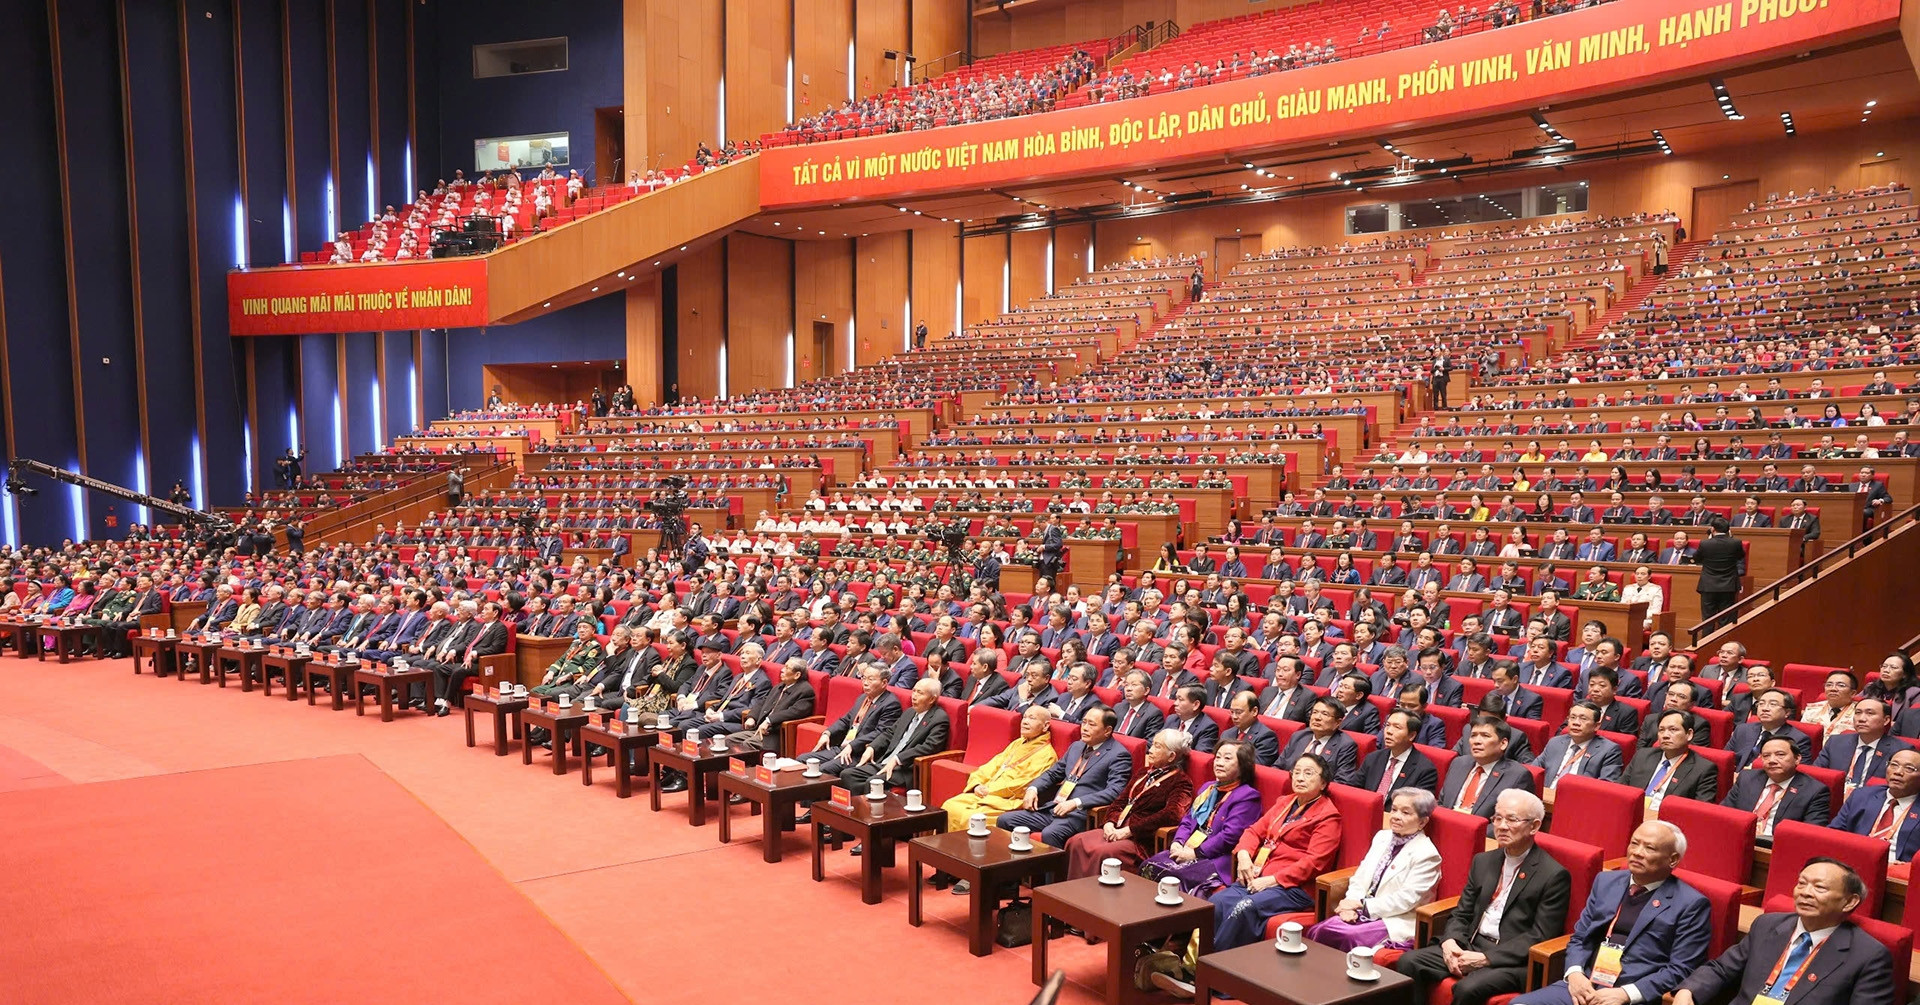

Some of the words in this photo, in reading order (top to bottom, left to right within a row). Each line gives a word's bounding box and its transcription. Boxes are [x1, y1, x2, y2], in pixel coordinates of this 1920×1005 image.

[792, 157, 819, 186] TẤT
[823, 150, 843, 183] CẢ
[846, 152, 861, 181] VÌ
[863, 152, 897, 181] MỘT
[899, 147, 942, 174] NƯỚC
[945, 141, 979, 171] VIỆT
[981, 137, 1020, 164] NAM
[1023, 129, 1057, 159] HÒA
[1059, 123, 1105, 156] BÌNH,
[1108, 114, 1144, 151] ĐỘC
[1147, 110, 1183, 144] LẬP,
[1186, 103, 1225, 135] DÂN
[1229, 91, 1272, 128] CHỦ,
[1276, 86, 1322, 120] GIÀU
[1326, 76, 1392, 114] MẠNH,
[1397, 58, 1456, 100] PHỒN
[1460, 52, 1519, 88] VINH,
[1524, 36, 1573, 76] VĂN
[1577, 23, 1651, 65] MINH,
[1658, 1, 1733, 49] HẠNH
[242, 298, 268, 315] VINH
[271, 295, 307, 316] QUANG
[310, 292, 331, 313] MÃI
[333, 291, 355, 312] MÃI
[357, 289, 393, 314] THUỘC
[394, 286, 409, 309] VỀ
[411, 286, 442, 308] NHÂN
[444, 284, 473, 306] DÂN!
